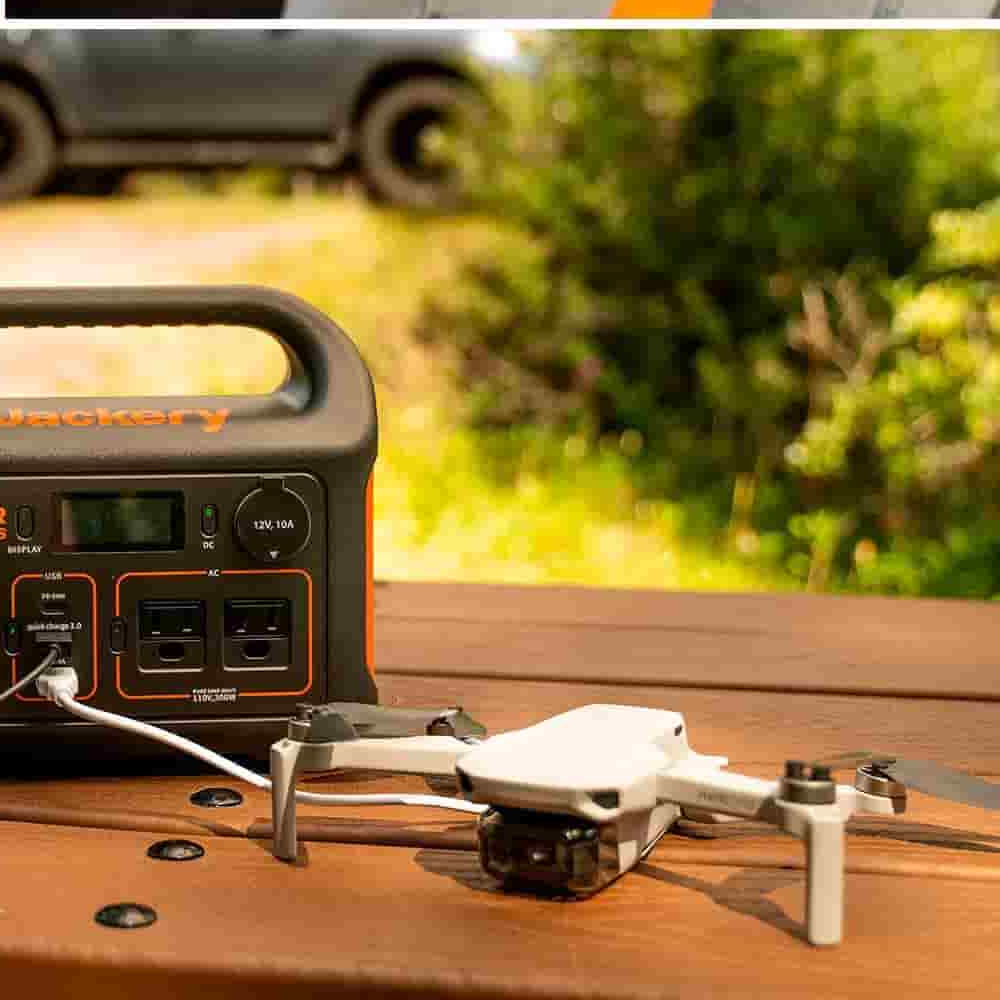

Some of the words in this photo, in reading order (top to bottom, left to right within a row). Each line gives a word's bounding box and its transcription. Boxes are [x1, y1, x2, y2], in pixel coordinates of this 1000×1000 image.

[8, 545, 42, 554] DISPLAY
[202, 541, 215, 550] DC
[208, 569, 220, 577] AC
